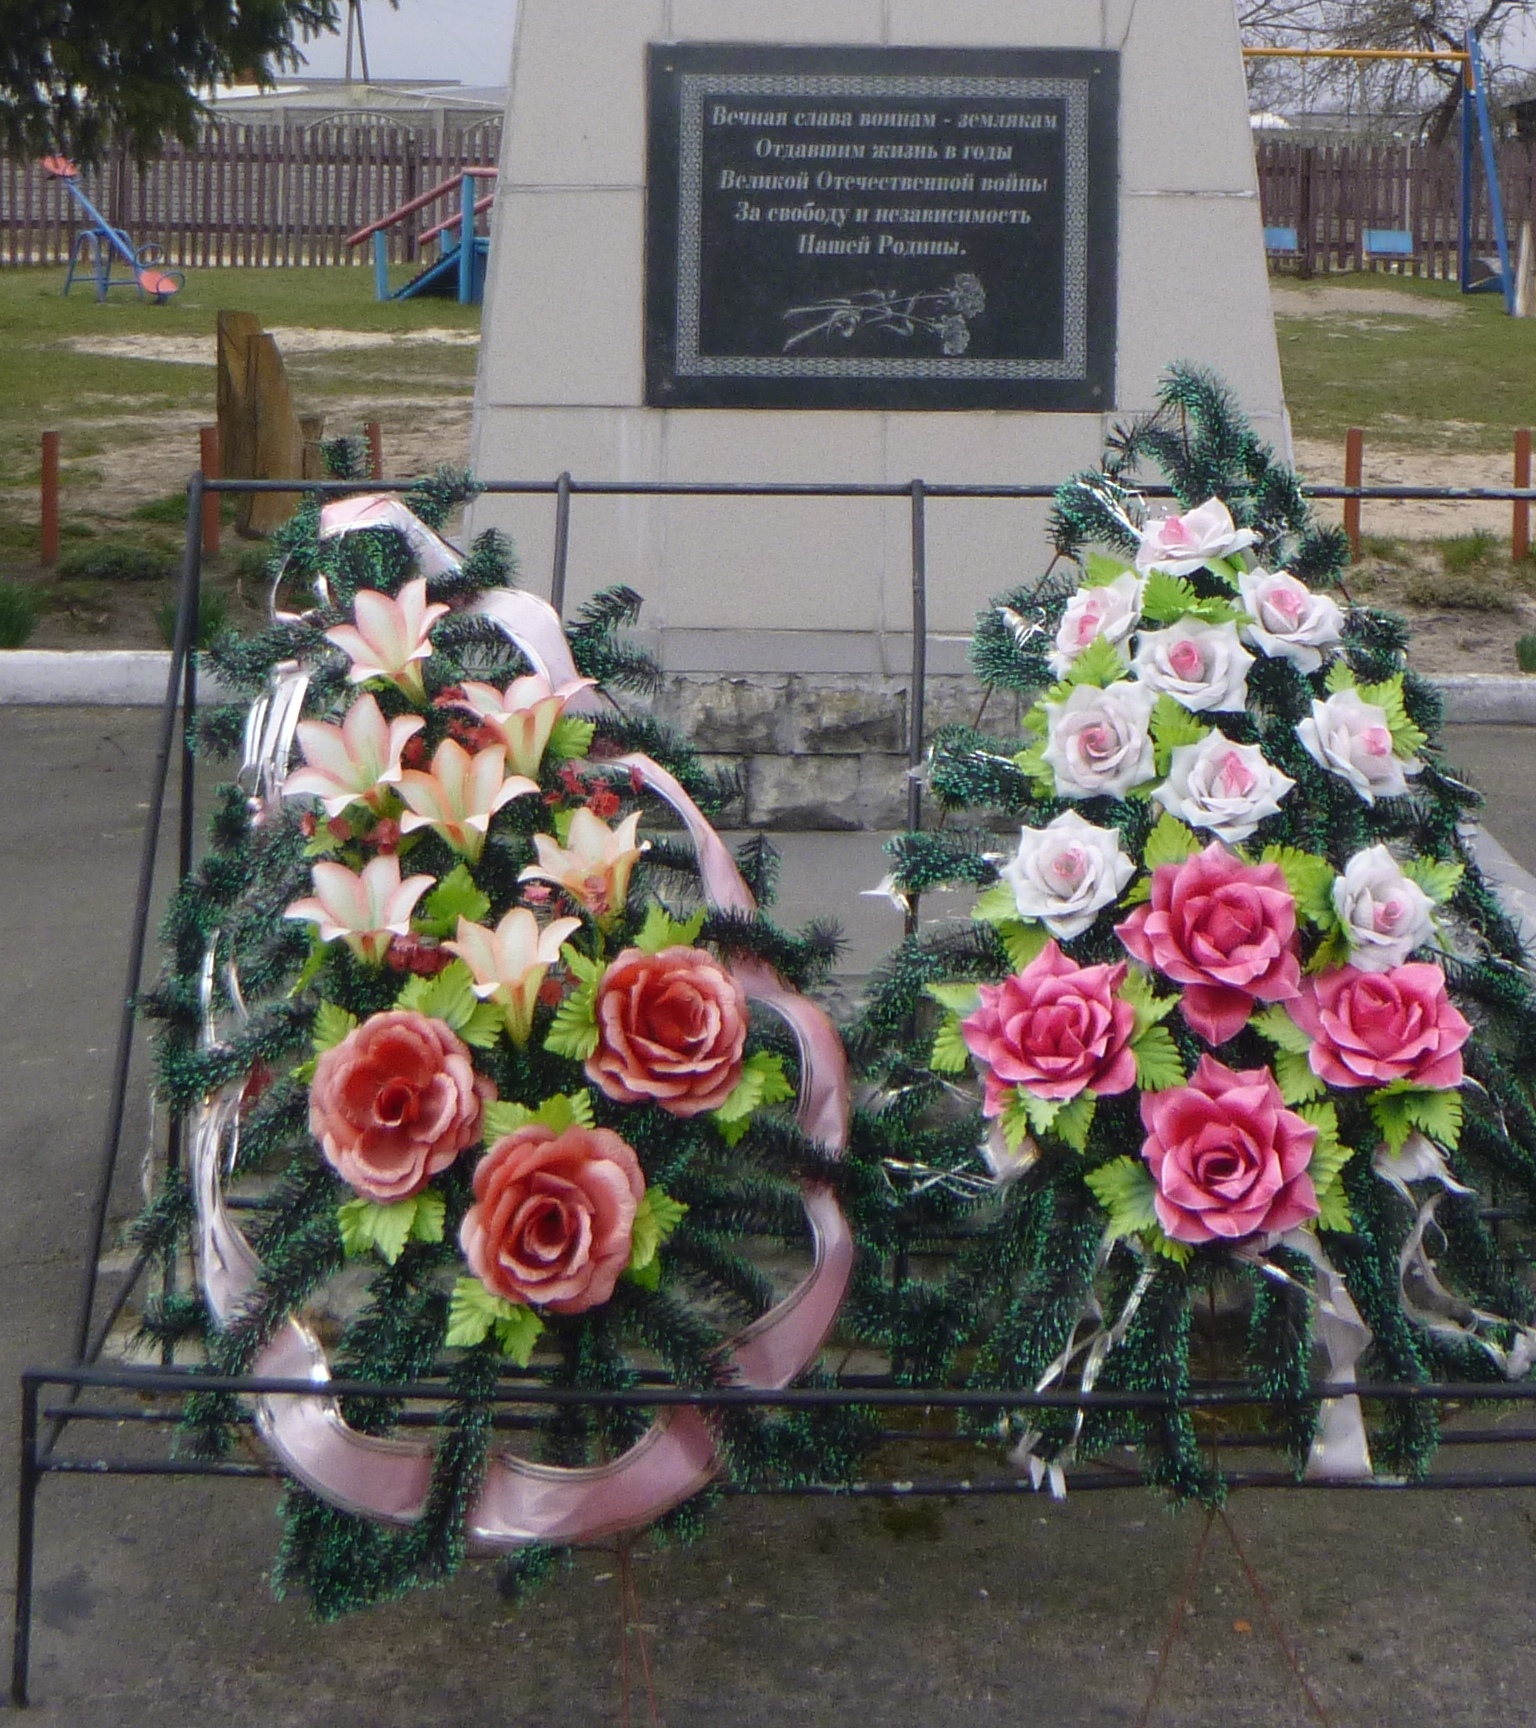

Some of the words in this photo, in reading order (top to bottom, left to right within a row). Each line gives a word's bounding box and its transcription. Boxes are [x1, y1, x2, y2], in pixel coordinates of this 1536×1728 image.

[712, 105, 788, 127] Вечная
[793, 111, 852, 127] слава
[859, 112, 937, 128] воинам
[957, 113, 1058, 129] землякам
[754, 138, 866, 160] Отдавшим
[871, 143, 939, 160] жизнь
[944, 144, 958, 160] в
[962, 144, 1013, 162] годы
[719, 168, 810, 191] Великой
[815, 170, 975, 192] Отечественной
[980, 172, 1049, 193] войны
[734, 200, 761, 222] За
[766, 201, 850, 229] свободу
[855, 207, 870, 223] и
[874, 208, 1033, 225] независимость
[797, 233, 872, 255] Нашей
[877, 234, 967, 258] Родины.
